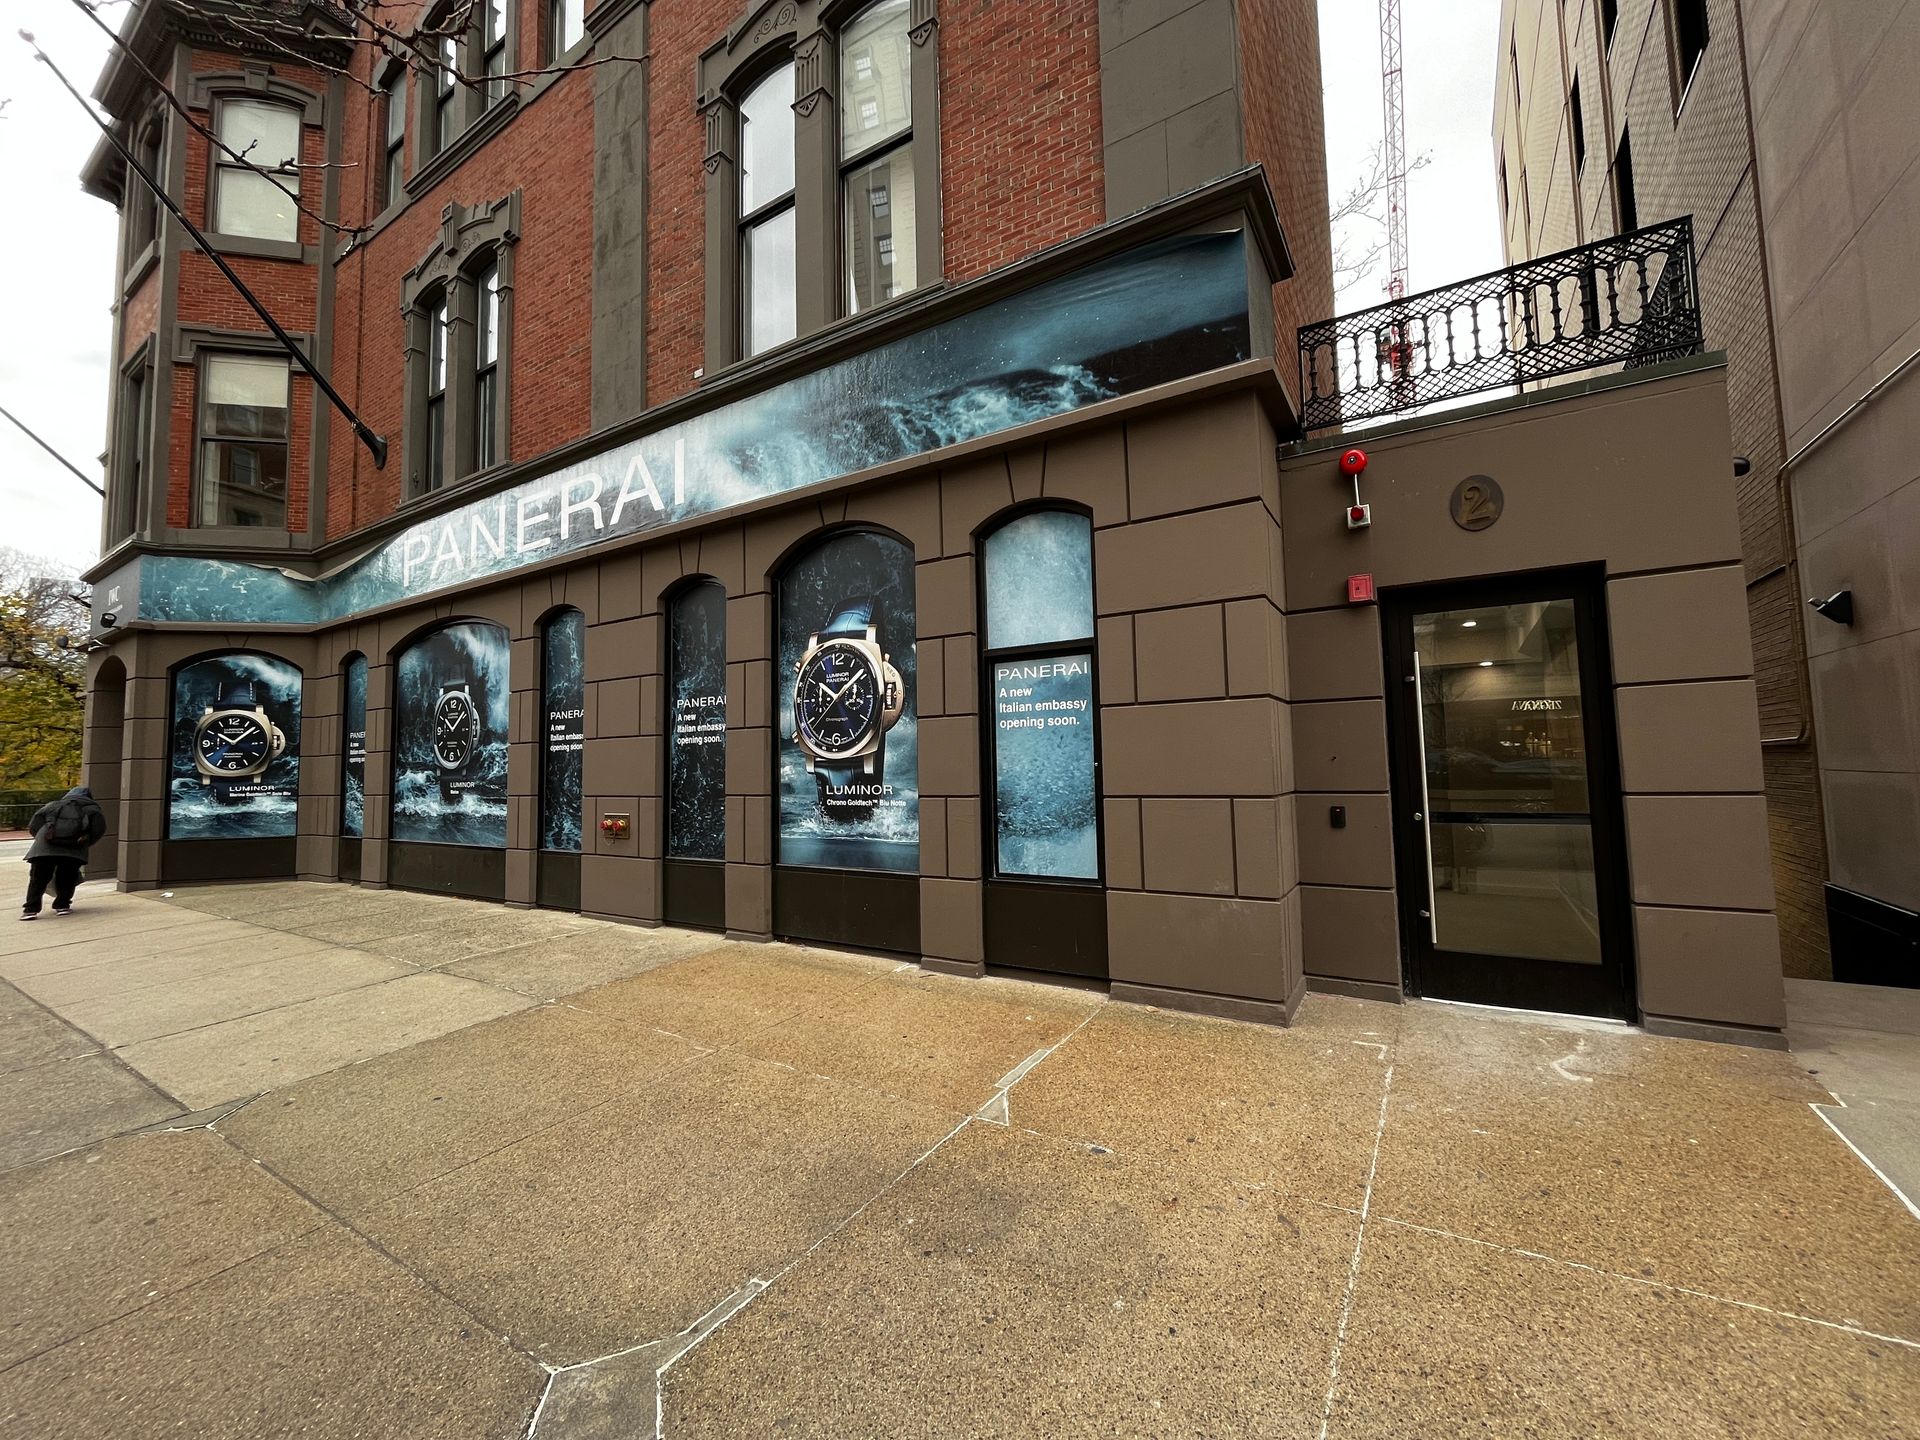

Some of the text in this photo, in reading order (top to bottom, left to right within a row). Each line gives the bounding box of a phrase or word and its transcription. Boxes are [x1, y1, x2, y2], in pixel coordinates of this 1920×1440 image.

[1462, 484, 1491, 523] 2
[403, 438, 685, 587] PANERAI
[831, 652, 845, 666] 12
[826, 671, 850, 679] LUMINOR
[998, 661, 1088, 681] PANERAI
[999, 687, 1033, 698] A new
[450, 699, 457, 709] 12
[676, 695, 727, 709] PANERAI
[999, 699, 1088, 713] Italian embassy
[228, 717, 240, 726] 12
[677, 713, 683, 722] A
[550, 724, 555, 732] A
[676, 723, 727, 733] Italian embassy
[999, 716, 1080, 731] opening soon.
[436, 726, 442, 736] 9
[202, 739, 211, 748] 9
[676, 735, 722, 747] opening soon.
[831, 732, 841, 746] 6
[449, 751, 455, 761] 6
[228, 761, 237, 770] 6
[826, 784, 893, 796] LUMINOR
[826, 798, 847, 806] Chrono
[879, 799, 890, 807] Blu
[890, 799, 907, 807] Notte
